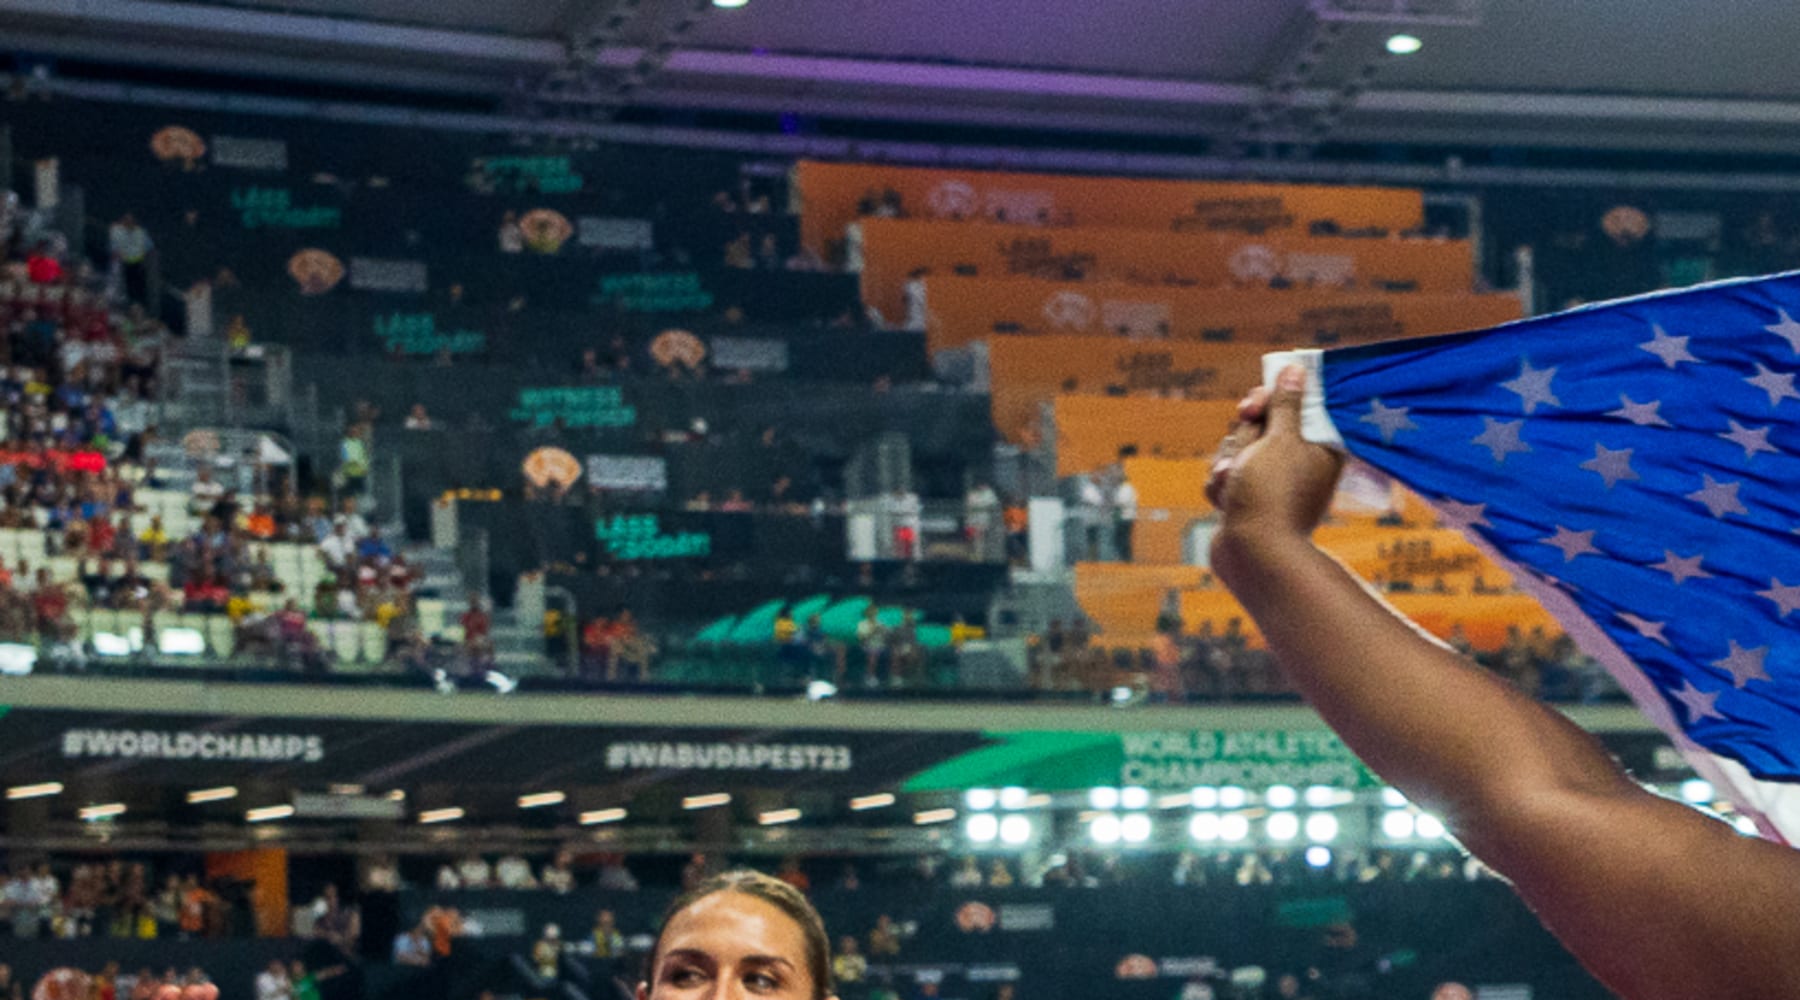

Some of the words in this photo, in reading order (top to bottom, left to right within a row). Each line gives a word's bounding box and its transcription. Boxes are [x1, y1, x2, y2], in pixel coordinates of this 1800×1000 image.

[63, 729, 324, 762] #WORLDCHAMPS
[607, 742, 851, 771] #WABUDAPEST23
[1123, 732, 1219, 759] WORLD
[1123, 760, 1359, 788] CHAMPIONSHIPS
